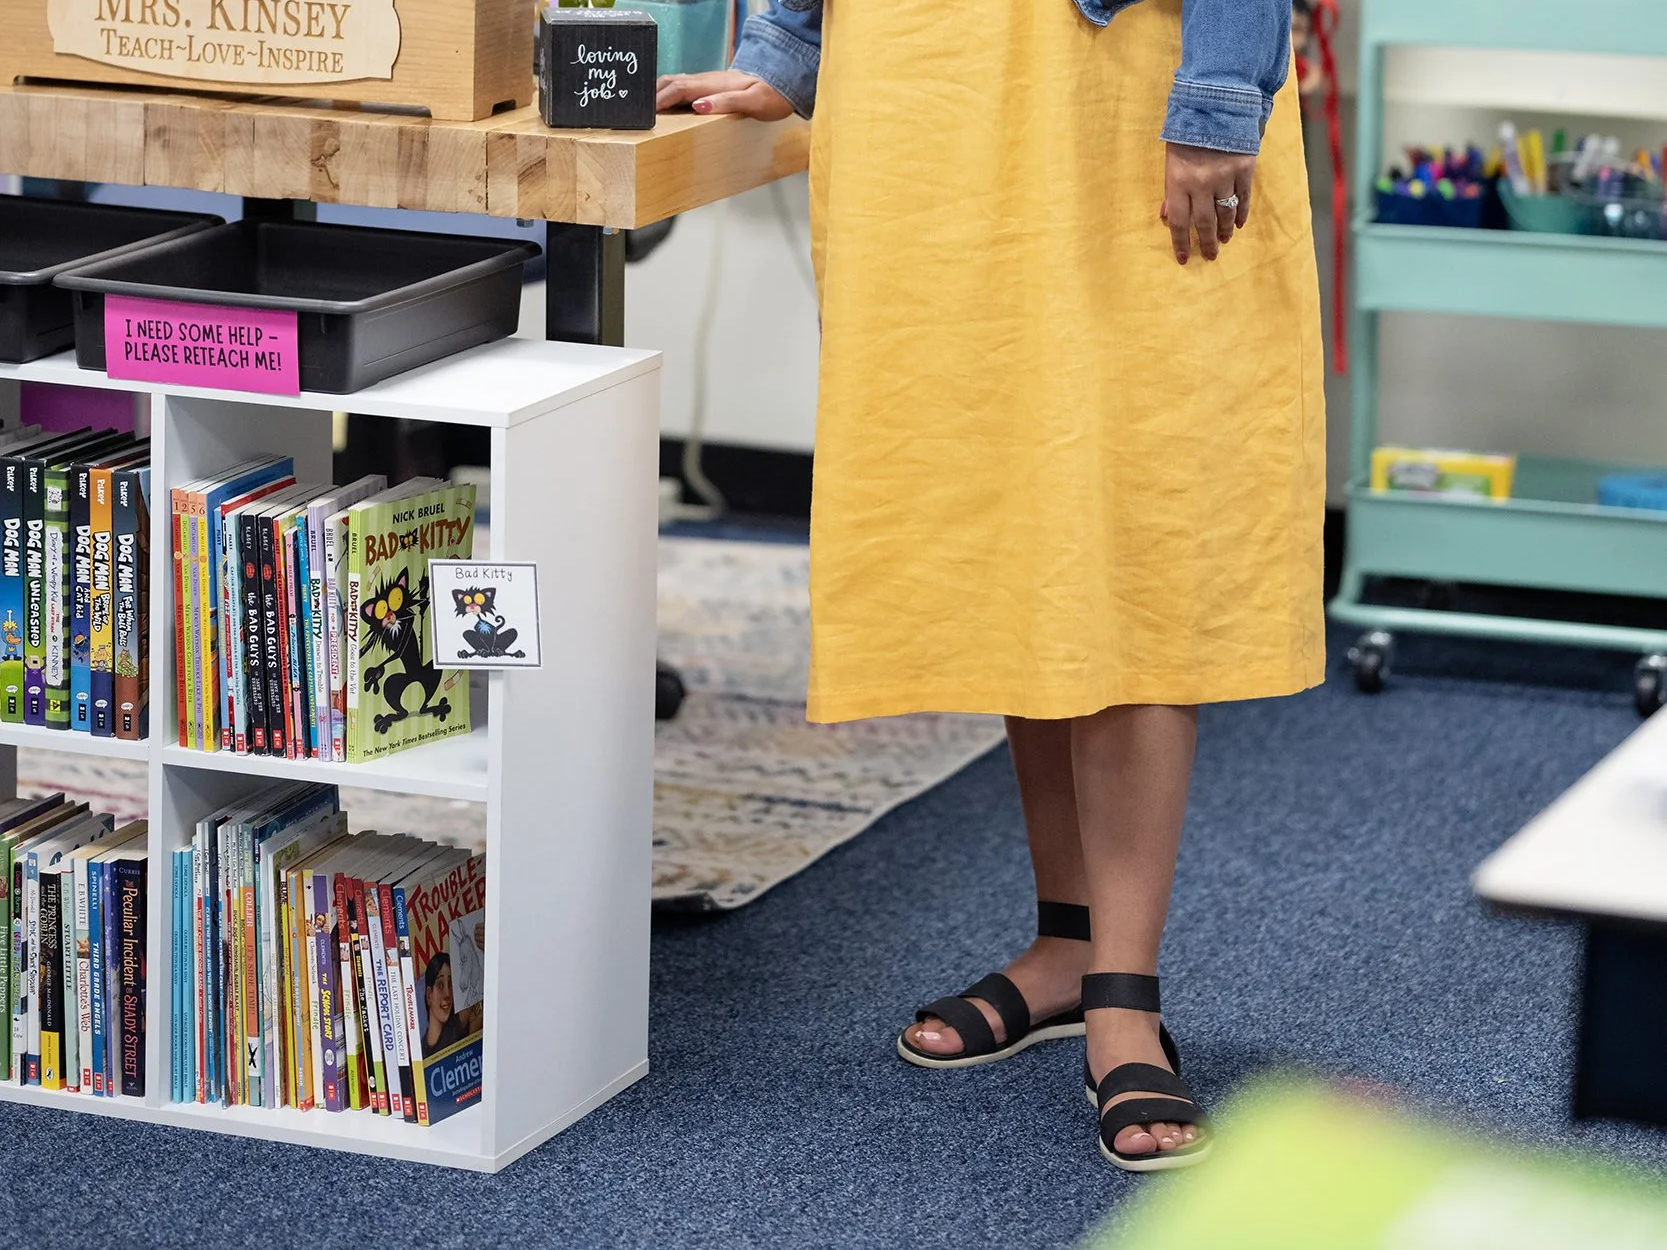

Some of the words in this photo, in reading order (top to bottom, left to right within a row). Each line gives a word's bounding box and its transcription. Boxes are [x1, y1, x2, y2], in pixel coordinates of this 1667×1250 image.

[570, 44, 638, 74] loving
[588, 68, 617, 89] my
[574, 81, 616, 107] job
[126, 319, 132, 338] I
[137, 320, 172, 340] NEED
[179, 322, 223, 344] SOME
[228, 326, 262, 346] HELP
[125, 342, 179, 364] PLEASE
[184, 346, 249, 368] RETEACH
[255, 352, 282, 370] ME!
[29, 467, 37, 492] PILKEY
[79, 472, 87, 497] PILKEY
[120, 481, 128, 506] PILKEY
[174, 502, 178, 511] 1
[182, 504, 187, 512] 2
[191, 505, 195, 514] 5
[199, 506, 205, 515] 6
[392, 510, 414, 524] NICK
[418, 503, 445, 519] BRUEL
[4, 518, 19, 546] DOG
[26, 519, 42, 549] DOG
[49, 532, 58, 553] Diary
[75, 525, 89, 553] DOG
[94, 531, 110, 560] DOG
[365, 532, 399, 566] BAD
[420, 516, 471, 554] KITTY
[117, 533, 133, 562] DOG
[4, 548, 19, 576] MAN
[26, 550, 42, 577] MAN
[75, 555, 89, 582] MAN
[94, 562, 109, 590] MAN
[456, 568, 478, 580] Bad
[482, 568, 513, 582] Kitty
[48, 566, 58, 589] Wimpy
[118, 564, 132, 592] MAN
[310, 578, 321, 597] BAD
[348, 581, 358, 600] BAD
[28, 580, 39, 646] UNLEASHED
[246, 592, 256, 606] the
[264, 594, 273, 608] the
[93, 612, 102, 631] WILD
[247, 608, 258, 633] BAD
[264, 611, 275, 634] BAD
[312, 609, 322, 639] KITTY
[348, 612, 357, 641] KITTY
[248, 636, 260, 666] GUYS
[266, 637, 277, 668] GUYS
[329, 630, 338, 674] PRESIDENT
[363, 747, 374, 757] The
[374, 745, 388, 754] New
[388, 740, 401, 750] York
[402, 736, 418, 745] Times
[418, 728, 448, 741] Bestselling
[448, 723, 466, 732] Series
[47, 884, 56, 902] THE
[335, 883, 346, 929] Clements
[406, 857, 482, 932] TROUBLE-
[121, 887, 137, 935] Peculiar
[380, 888, 393, 934] Clements
[394, 894, 406, 929] Clements
[39, 908, 48, 944] GOBLIN
[47, 905, 57, 948] PRINCESS
[123, 938, 138, 986] Incident
[375, 959, 383, 976] THE
[78, 960, 89, 1009] Charlotte's
[389, 970, 397, 983] THE
[320, 988, 332, 1015] SCHOOL
[343, 989, 352, 1019] Frindle
[376, 979, 390, 1020] REPORT
[390, 985, 399, 1001] LAST
[405, 984, 417, 1029] TROUBLEMAKER
[80, 1012, 90, 1031] Web
[124, 994, 137, 1031] SHADY
[310, 1000, 319, 1029] Frindle
[360, 1005, 369, 1032] Jacket
[392, 1002, 402, 1028] HOLIDAY
[322, 1016, 332, 1040] STORY
[382, 1023, 394, 1051] CARD
[124, 1034, 137, 1076] STREET
[396, 1030, 406, 1061] CONCERT
